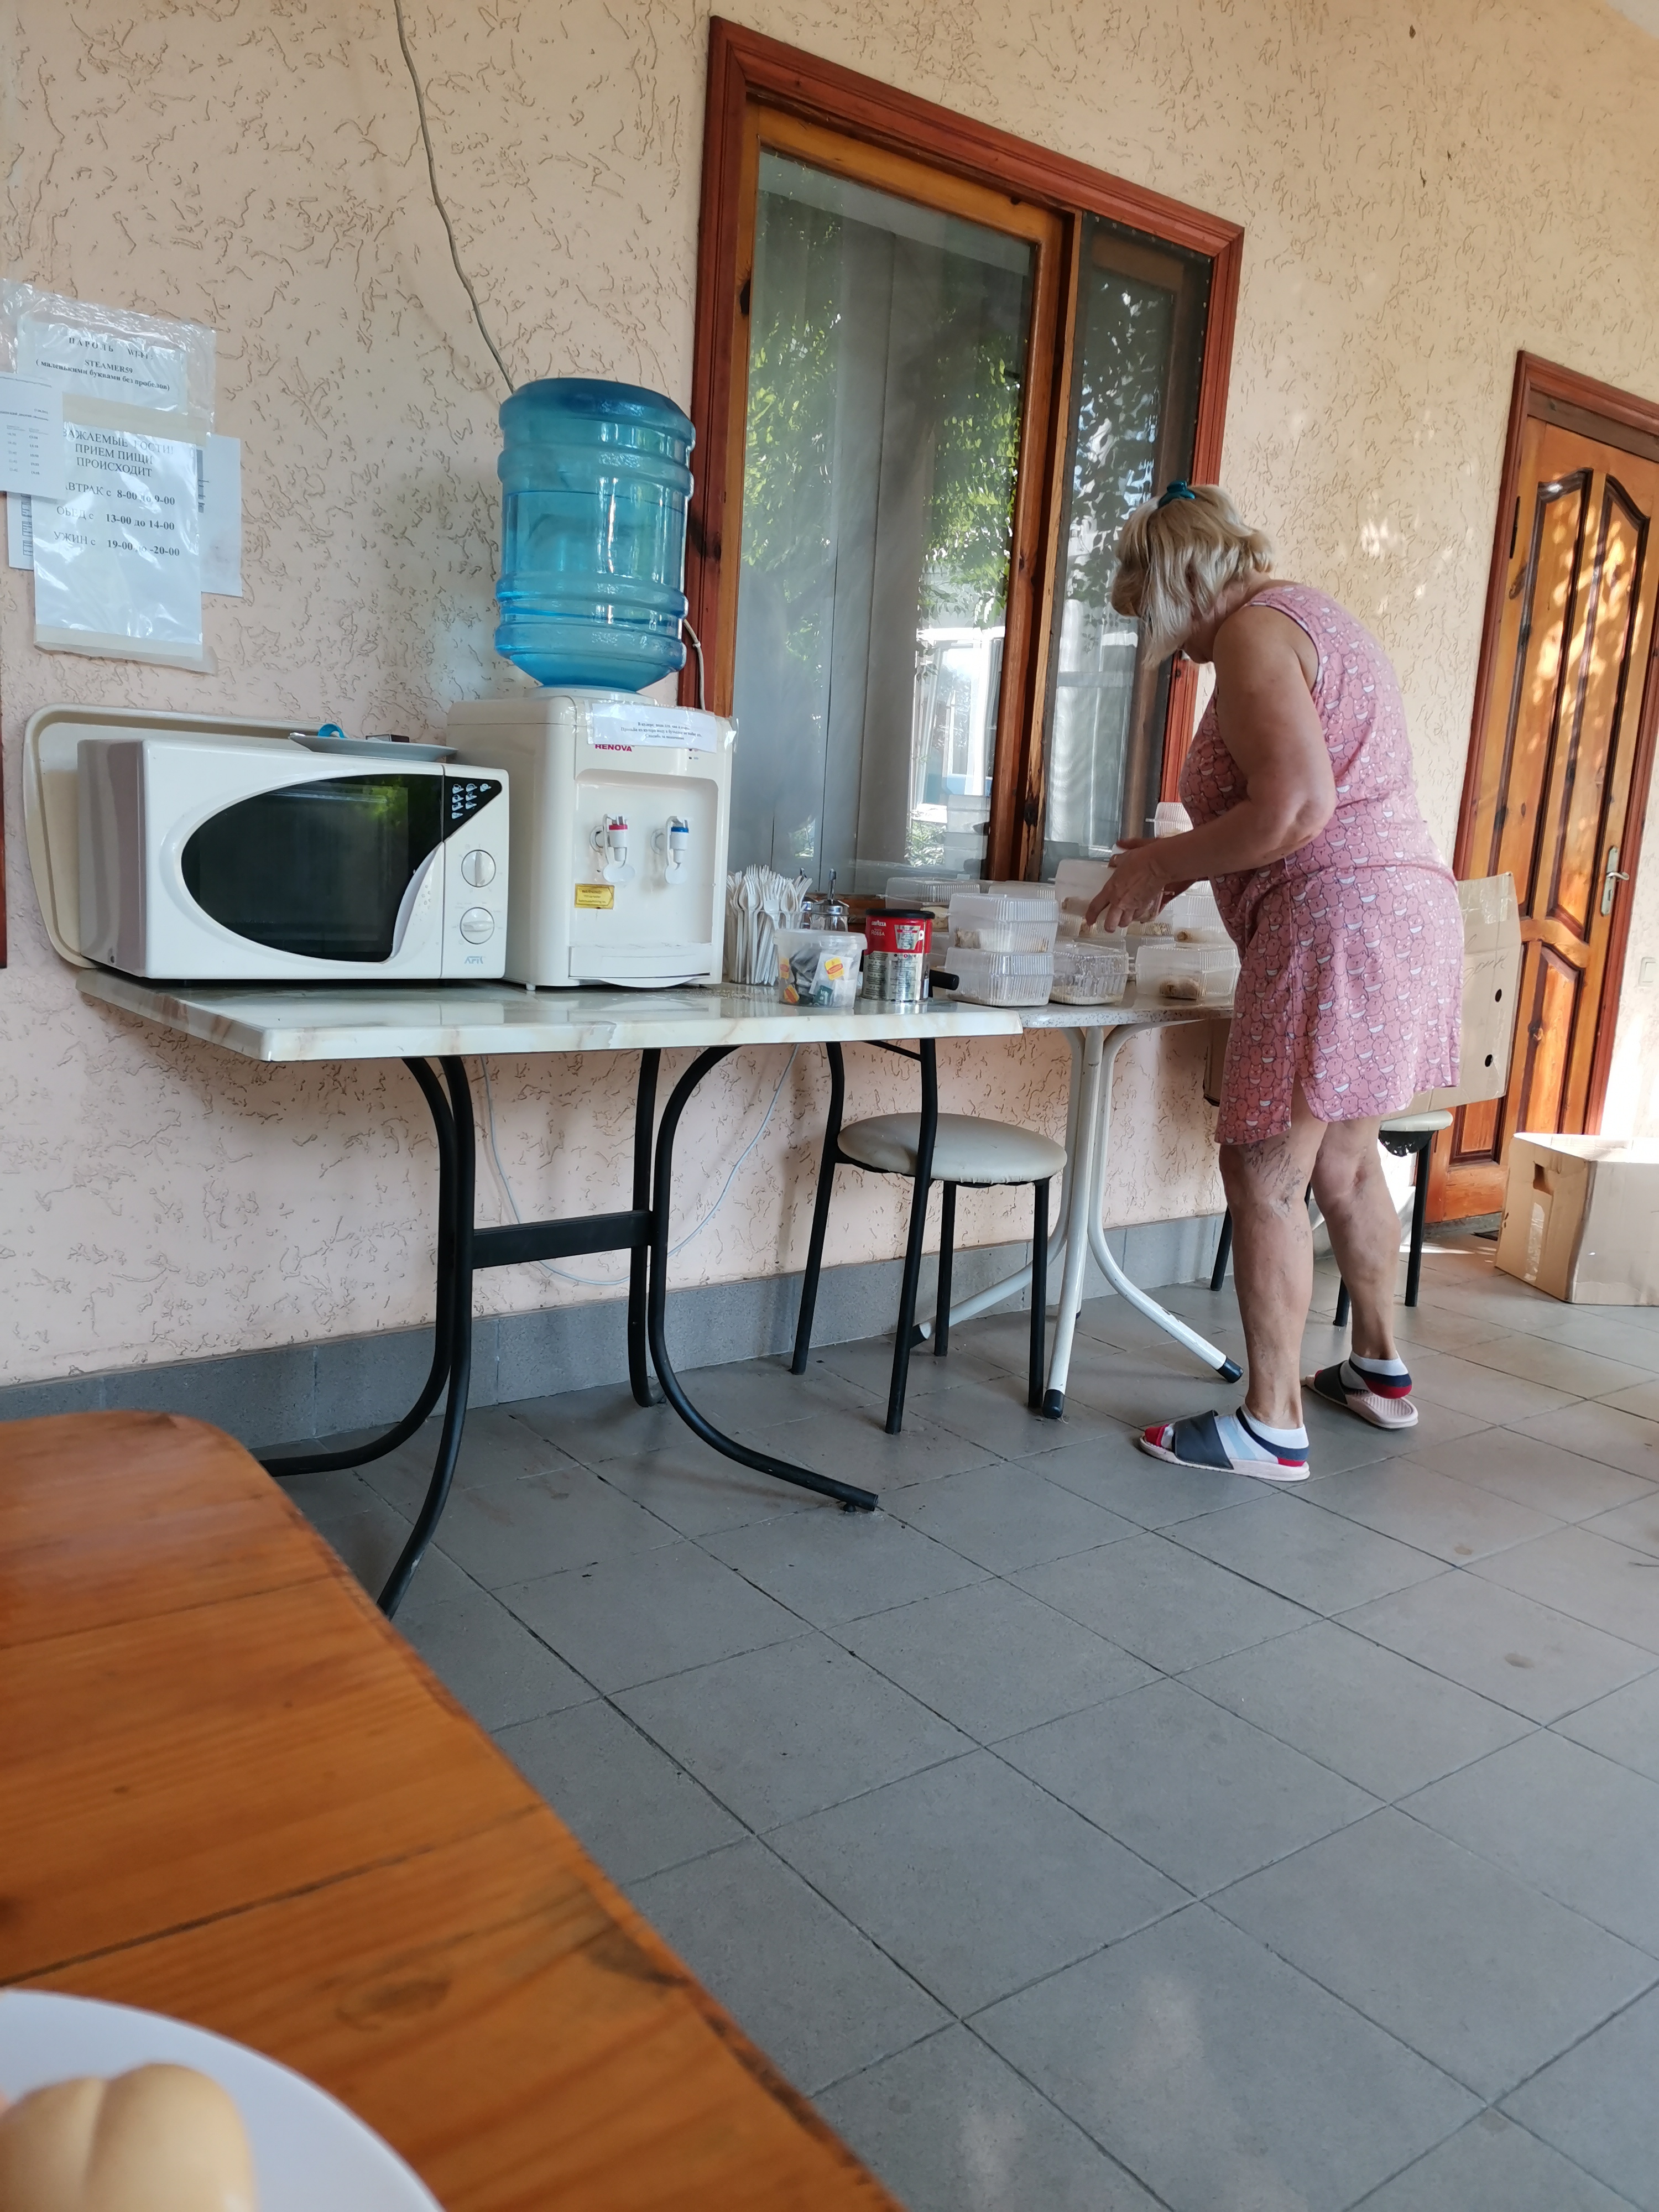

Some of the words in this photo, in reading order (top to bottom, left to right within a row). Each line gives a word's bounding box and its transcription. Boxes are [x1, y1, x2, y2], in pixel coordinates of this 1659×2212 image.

[69, 337, 114, 352] ПАРОЛЬ
[84, 359, 133, 374] STEAMER59
[90, 370, 121, 380] буквами
[63, 428, 128, 447] ВАЖАЕМЫЕ
[75, 443, 114, 458] ПРИЕМ
[118, 450, 153, 465] ПИЩИ
[76, 457, 153, 477] ПРОИСХОДИТ
[66, 482, 104, 496] ВТРАК
[117, 489, 137, 500] 8-00
[154, 495, 175, 505] 9-00
[106, 513, 132, 525] 13-00
[134, 519, 145, 527] до
[149, 520, 175, 530] 14-00
[54, 531, 87, 545] УЖИН
[107, 540, 133, 551] 19-00
[149, 546, 180, 556] -20-00
